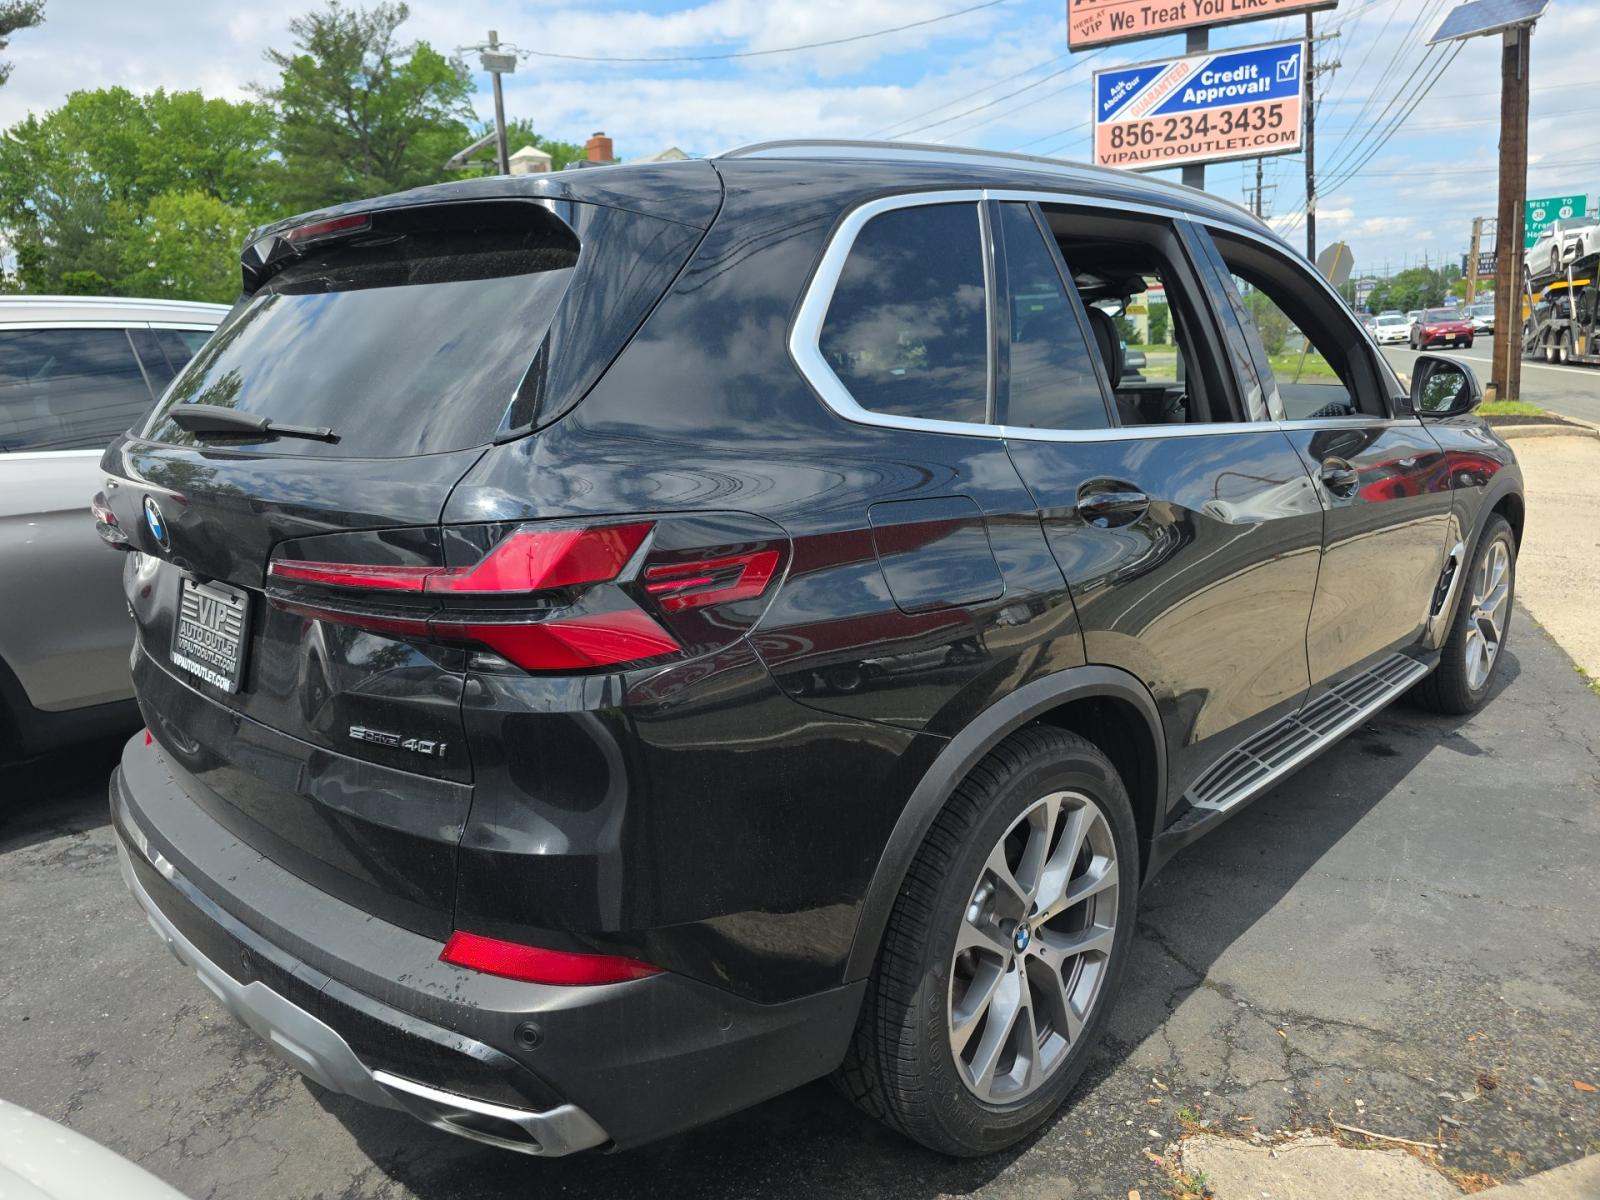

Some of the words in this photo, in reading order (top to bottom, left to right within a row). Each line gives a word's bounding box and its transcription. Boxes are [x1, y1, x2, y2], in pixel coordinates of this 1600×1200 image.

[1081, 20, 1102, 37] VIP
[1109, 11, 1135, 31] We
[1140, 2, 1186, 26] Treat
[1194, 0, 1224, 16] You
[1110, 81, 1125, 97] Ask
[1182, 77, 1271, 104] Approval!
[1201, 65, 1259, 86] Credit
[1110, 103, 1283, 149] 856-234-3435
[1100, 130, 1296, 164] VIPAUTOOUTLET.COM
[197, 595, 229, 631] VIP
[179, 621, 203, 642] AUTO
[204, 630, 238, 658] OUTLET
[172, 651, 232, 693] VIPAUTOOUTLET.COM
